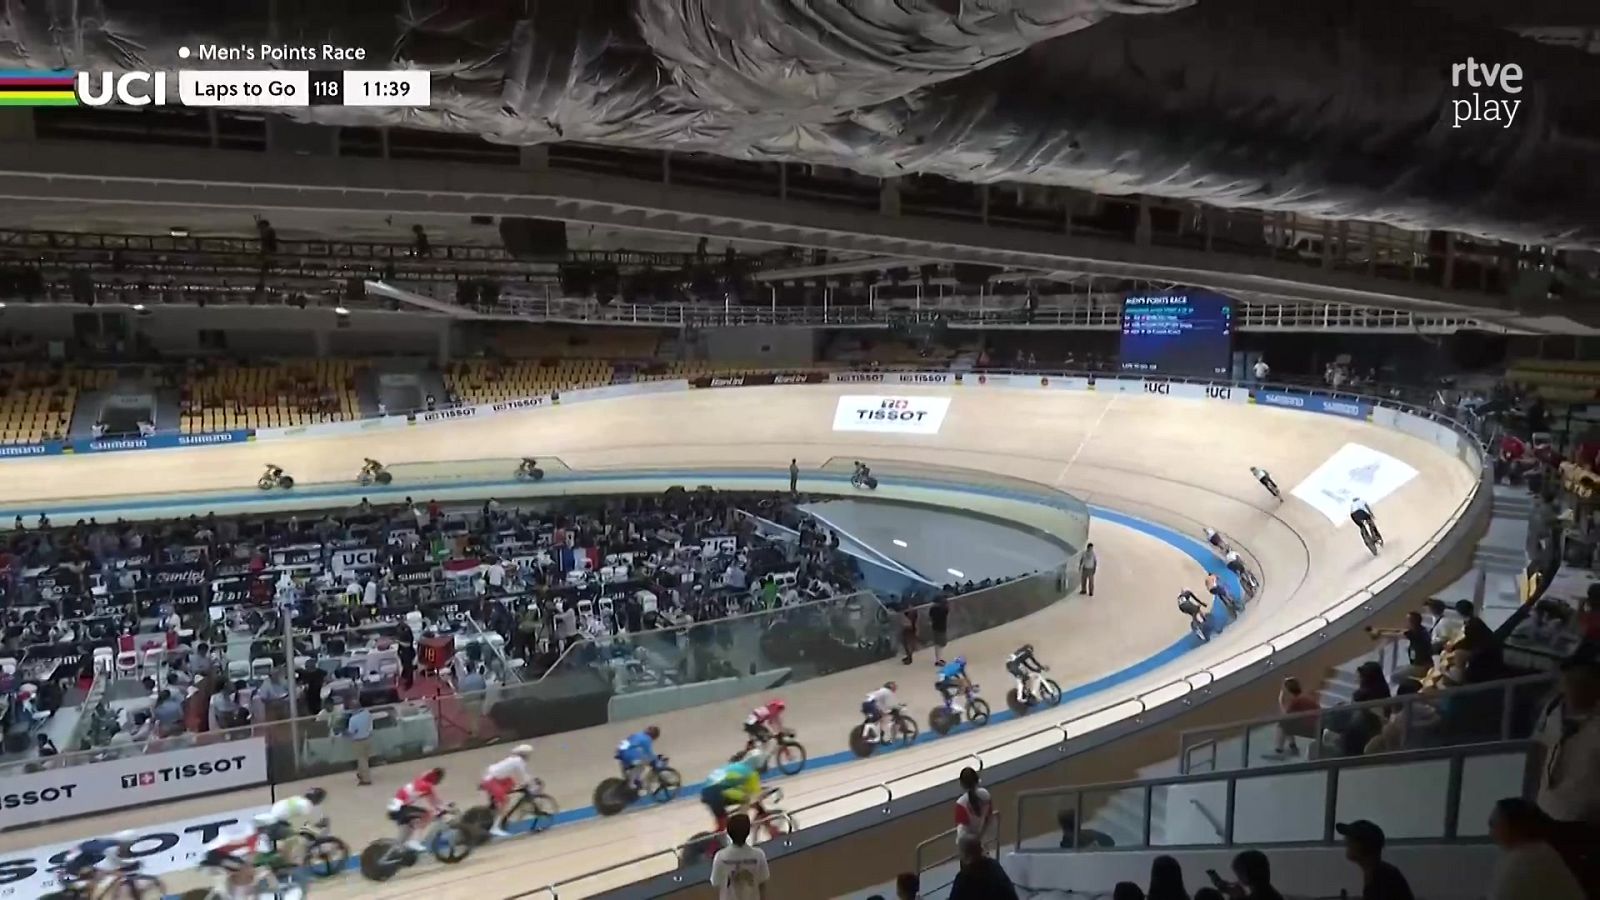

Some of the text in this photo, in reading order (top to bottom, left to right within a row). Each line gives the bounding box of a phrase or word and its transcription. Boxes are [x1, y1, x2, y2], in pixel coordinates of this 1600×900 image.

[1149, 382, 1170, 394] UCI
[1210, 387, 1231, 399] UCI
[509, 398, 543, 408] TISSOT
[441, 408, 476, 419] TISSOT
[856, 409, 928, 421] TISSOT
[343, 552, 374, 565] UCI
[158, 756, 247, 782] TISSOT
[0, 784, 77, 810] SSOT
